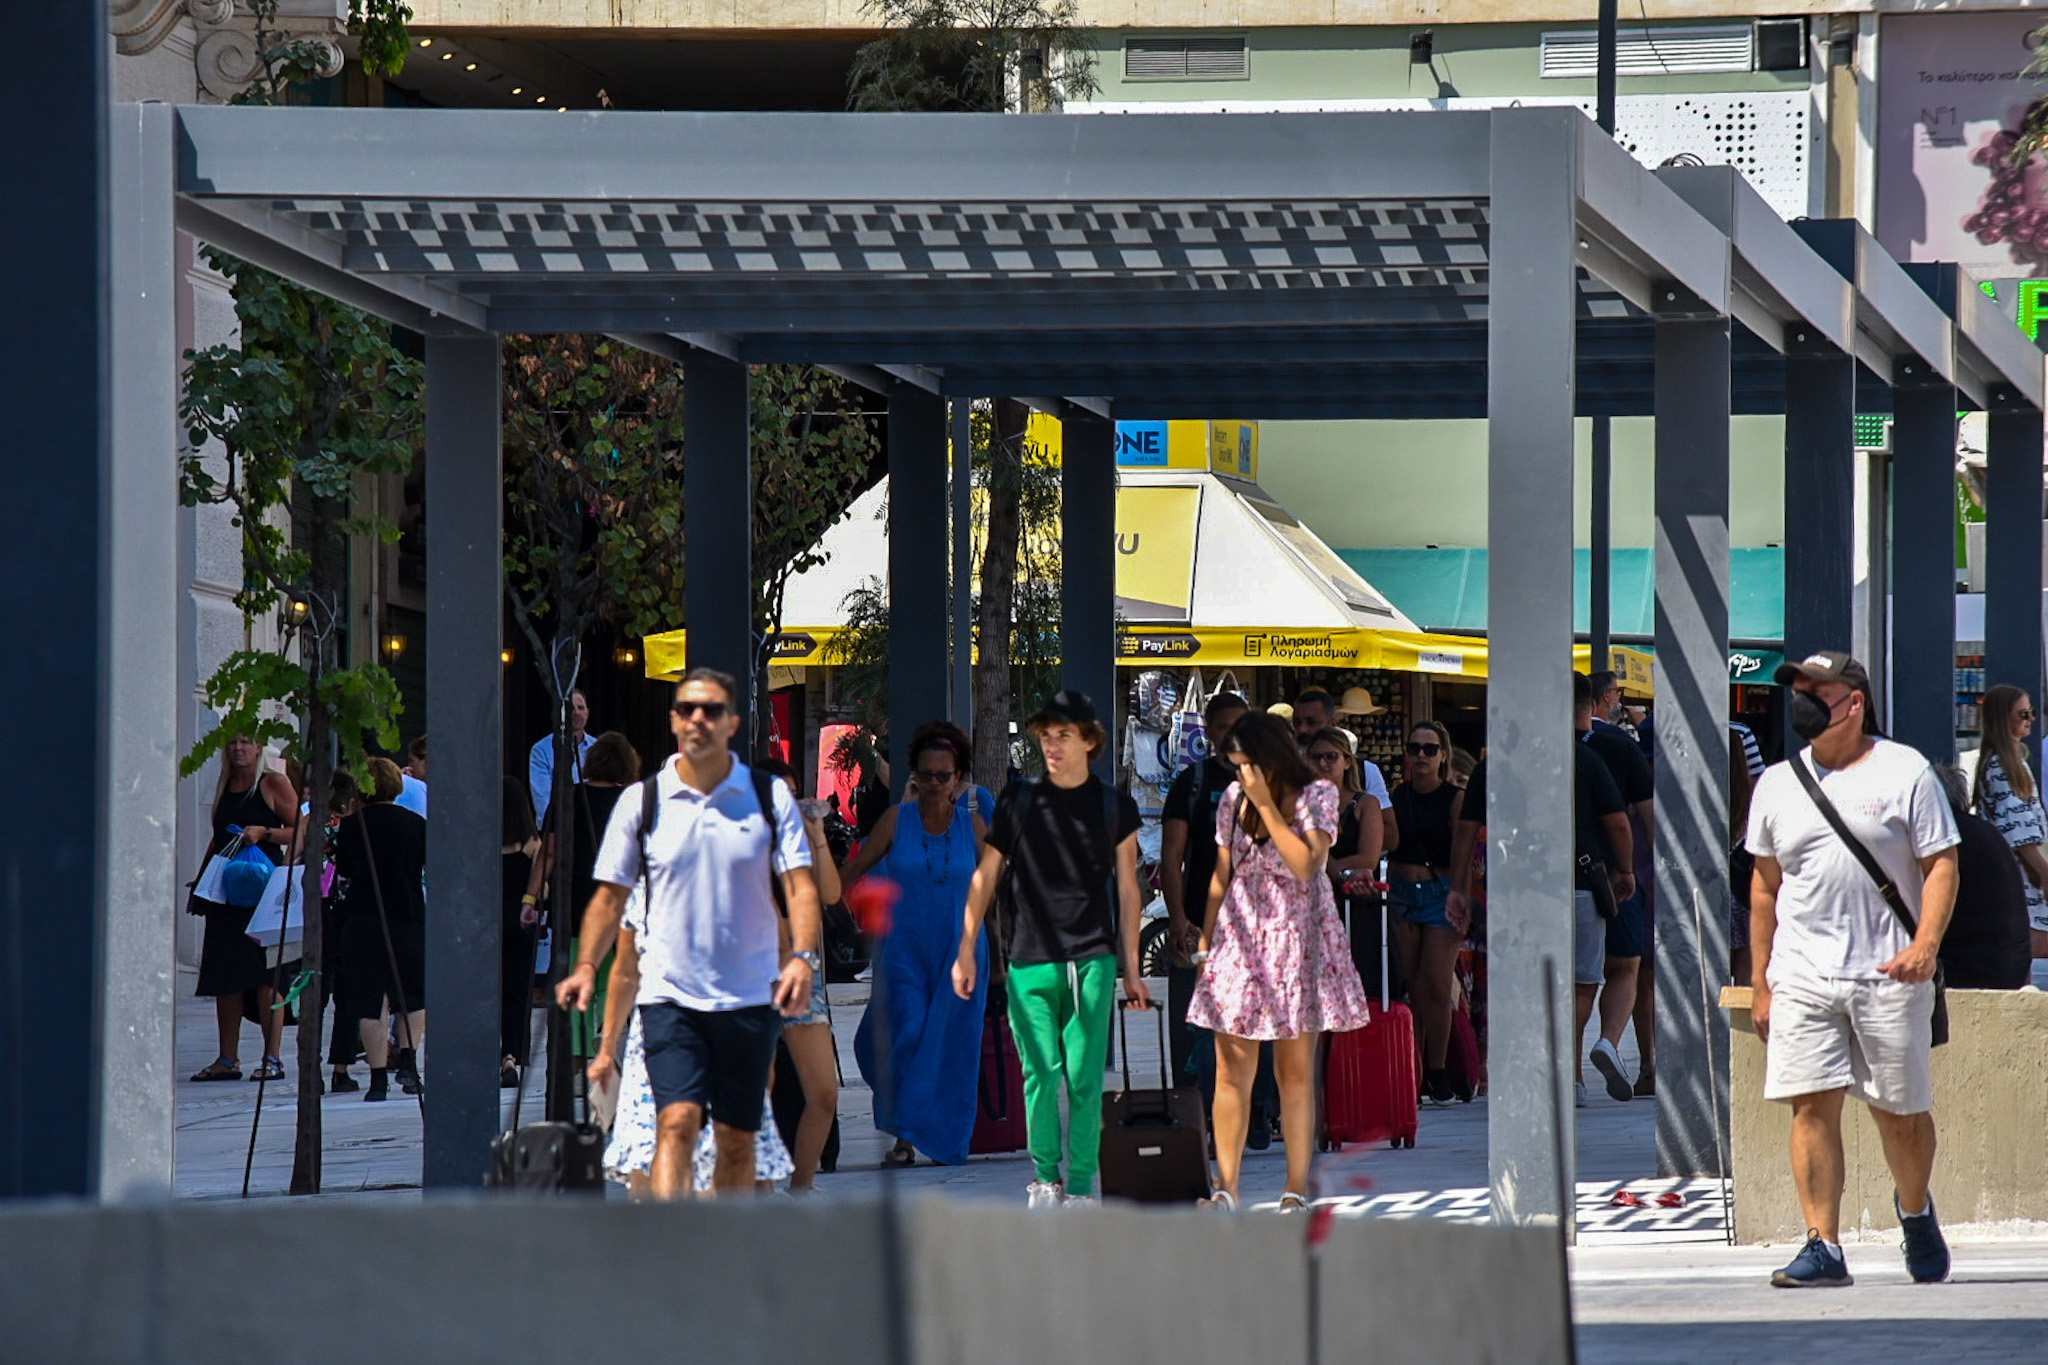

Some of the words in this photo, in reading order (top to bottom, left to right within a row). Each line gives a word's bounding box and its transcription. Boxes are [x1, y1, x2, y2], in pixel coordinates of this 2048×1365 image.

[774, 639, 806, 653] yLink
[1142, 638, 1190, 654] PayLink
[1270, 634, 1331, 648] Πληρωμή
[1270, 647, 1359, 660] Λογαριασμών
